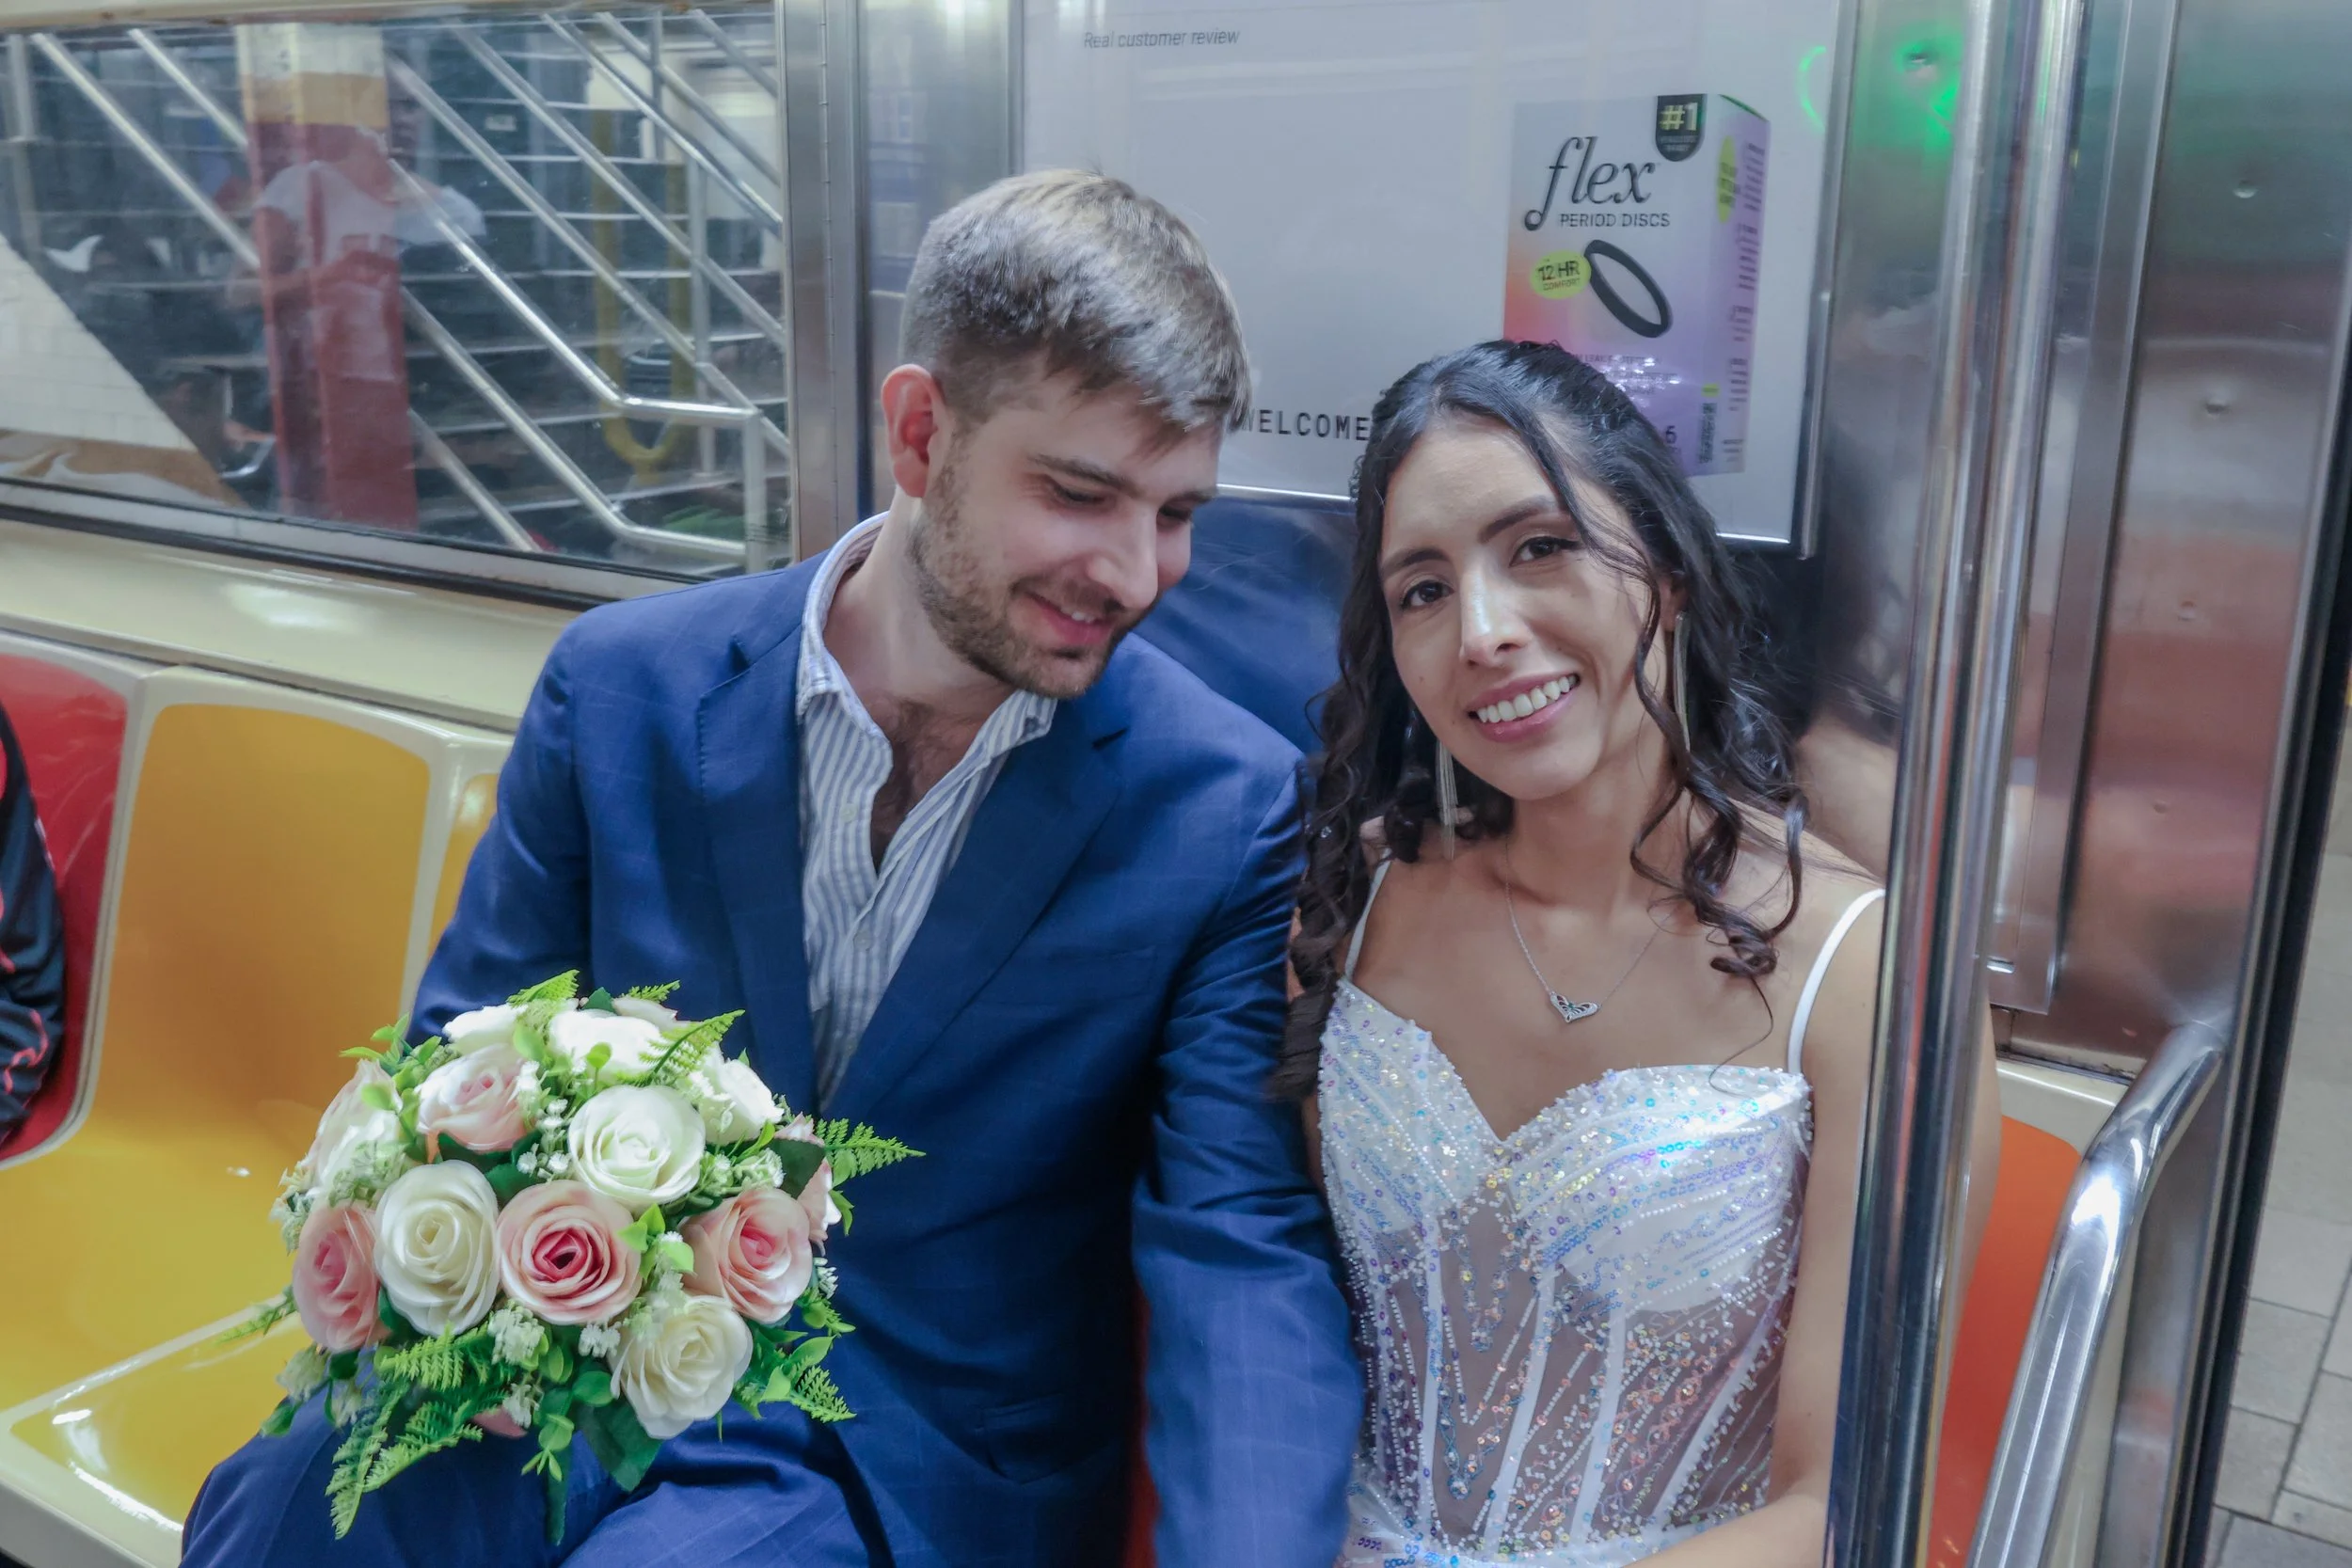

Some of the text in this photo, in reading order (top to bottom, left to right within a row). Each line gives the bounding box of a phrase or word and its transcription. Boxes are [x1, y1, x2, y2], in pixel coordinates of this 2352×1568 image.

[1084, 28, 1240, 48] Real customer review
[1660, 103, 1697, 131] #1
[1524, 135, 1656, 231] flex
[1561, 213, 1670, 228] PERIOD DISCS
[1536, 260, 1581, 281] 12 HR
